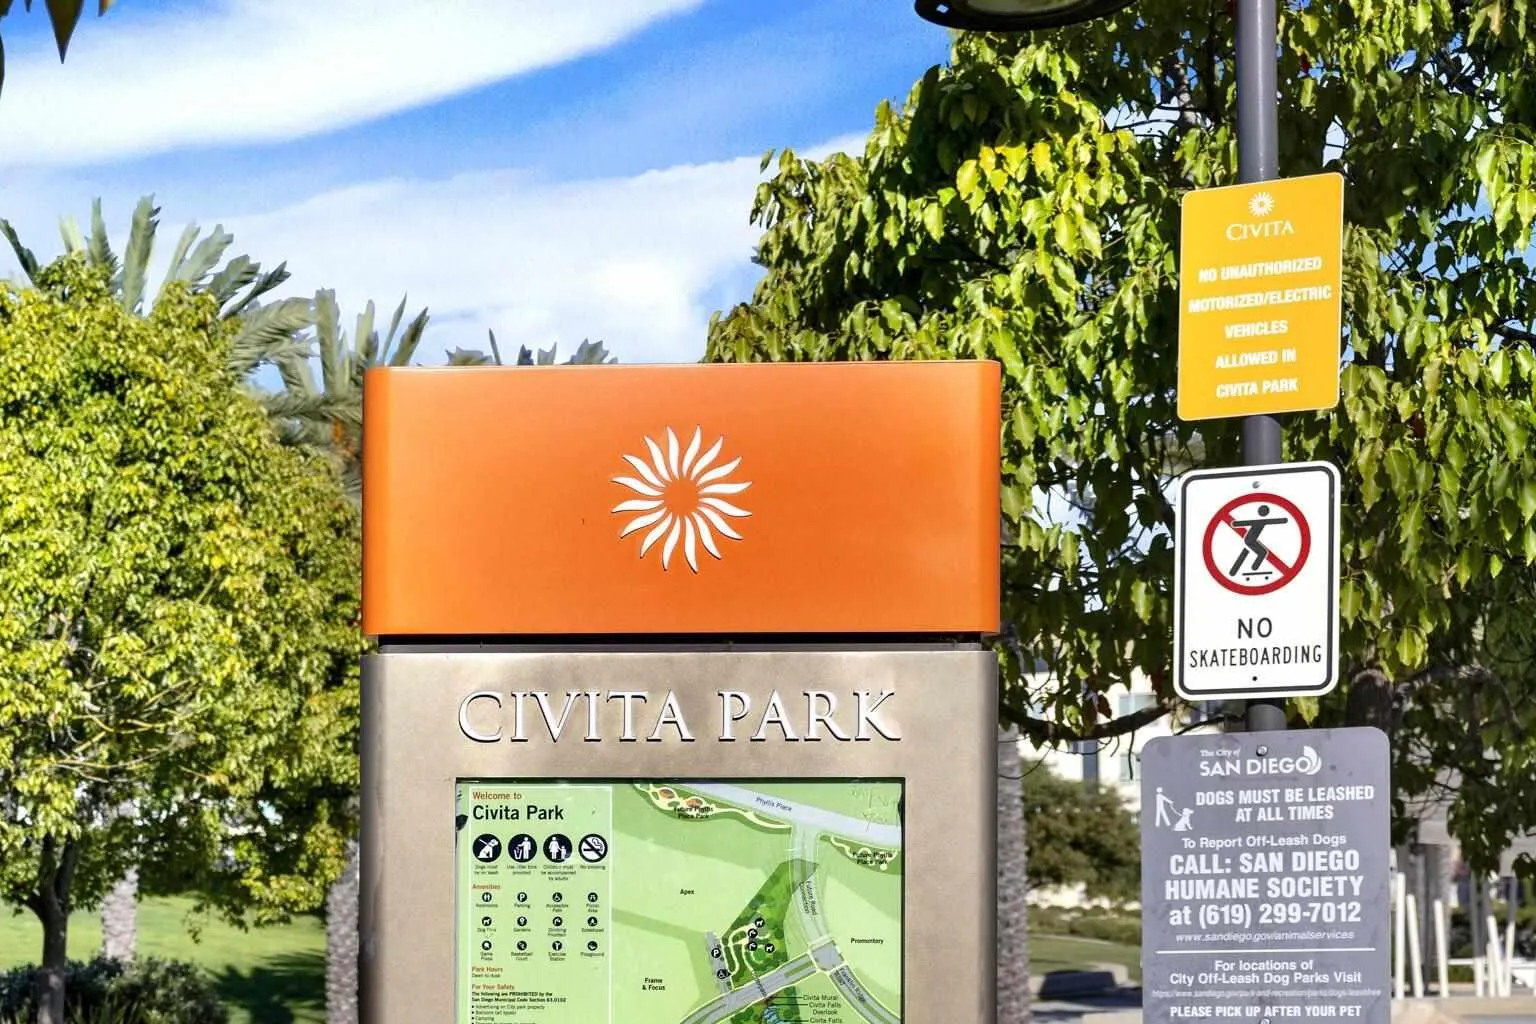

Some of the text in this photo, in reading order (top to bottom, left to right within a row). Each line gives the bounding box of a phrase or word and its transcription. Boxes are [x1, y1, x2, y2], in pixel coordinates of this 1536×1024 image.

[1226, 220, 1295, 241] CIVITA
[1198, 256, 1322, 283] NO UNAUTHORIZED
[1188, 285, 1332, 313] MOTORIZED/ELECTRIC
[1225, 320, 1288, 338] VEHICLES
[1215, 348, 1296, 369] ALLOWED IN
[1215, 377, 1299, 398] CIVITA PARK
[1237, 617, 1273, 639] NO
[1190, 645, 1321, 668] SKATEBOARDING
[457, 688, 902, 743] CIVITA PARK
[1200, 748, 1241, 758] The City of
[1199, 757, 1314, 777] SAN DIEGO
[472, 791, 522, 800] Welcome to
[1195, 786, 1375, 806] DOGS MUST BE LEASHED
[472, 805, 564, 820] Civita Park
[1235, 805, 1334, 822] AT ALL TIMES
[1182, 834, 1347, 850] To Report Off-Leash Dogs
[1169, 849, 1360, 875] CALL: SAN DIEGO
[680, 888, 695, 896] Apex
[1165, 875, 1364, 900] HUMANE SOCIETY
[1169, 901, 1361, 929] at (619) 299-7012
[850, 937, 884, 945] Promontory
[1214, 959, 1314, 971] For locations of
[1169, 971, 1362, 986] City Off-Leash Dog Parks Visit
[1169, 1005, 1362, 1017] PLEASE PICK UP AFTER YOUR PET
